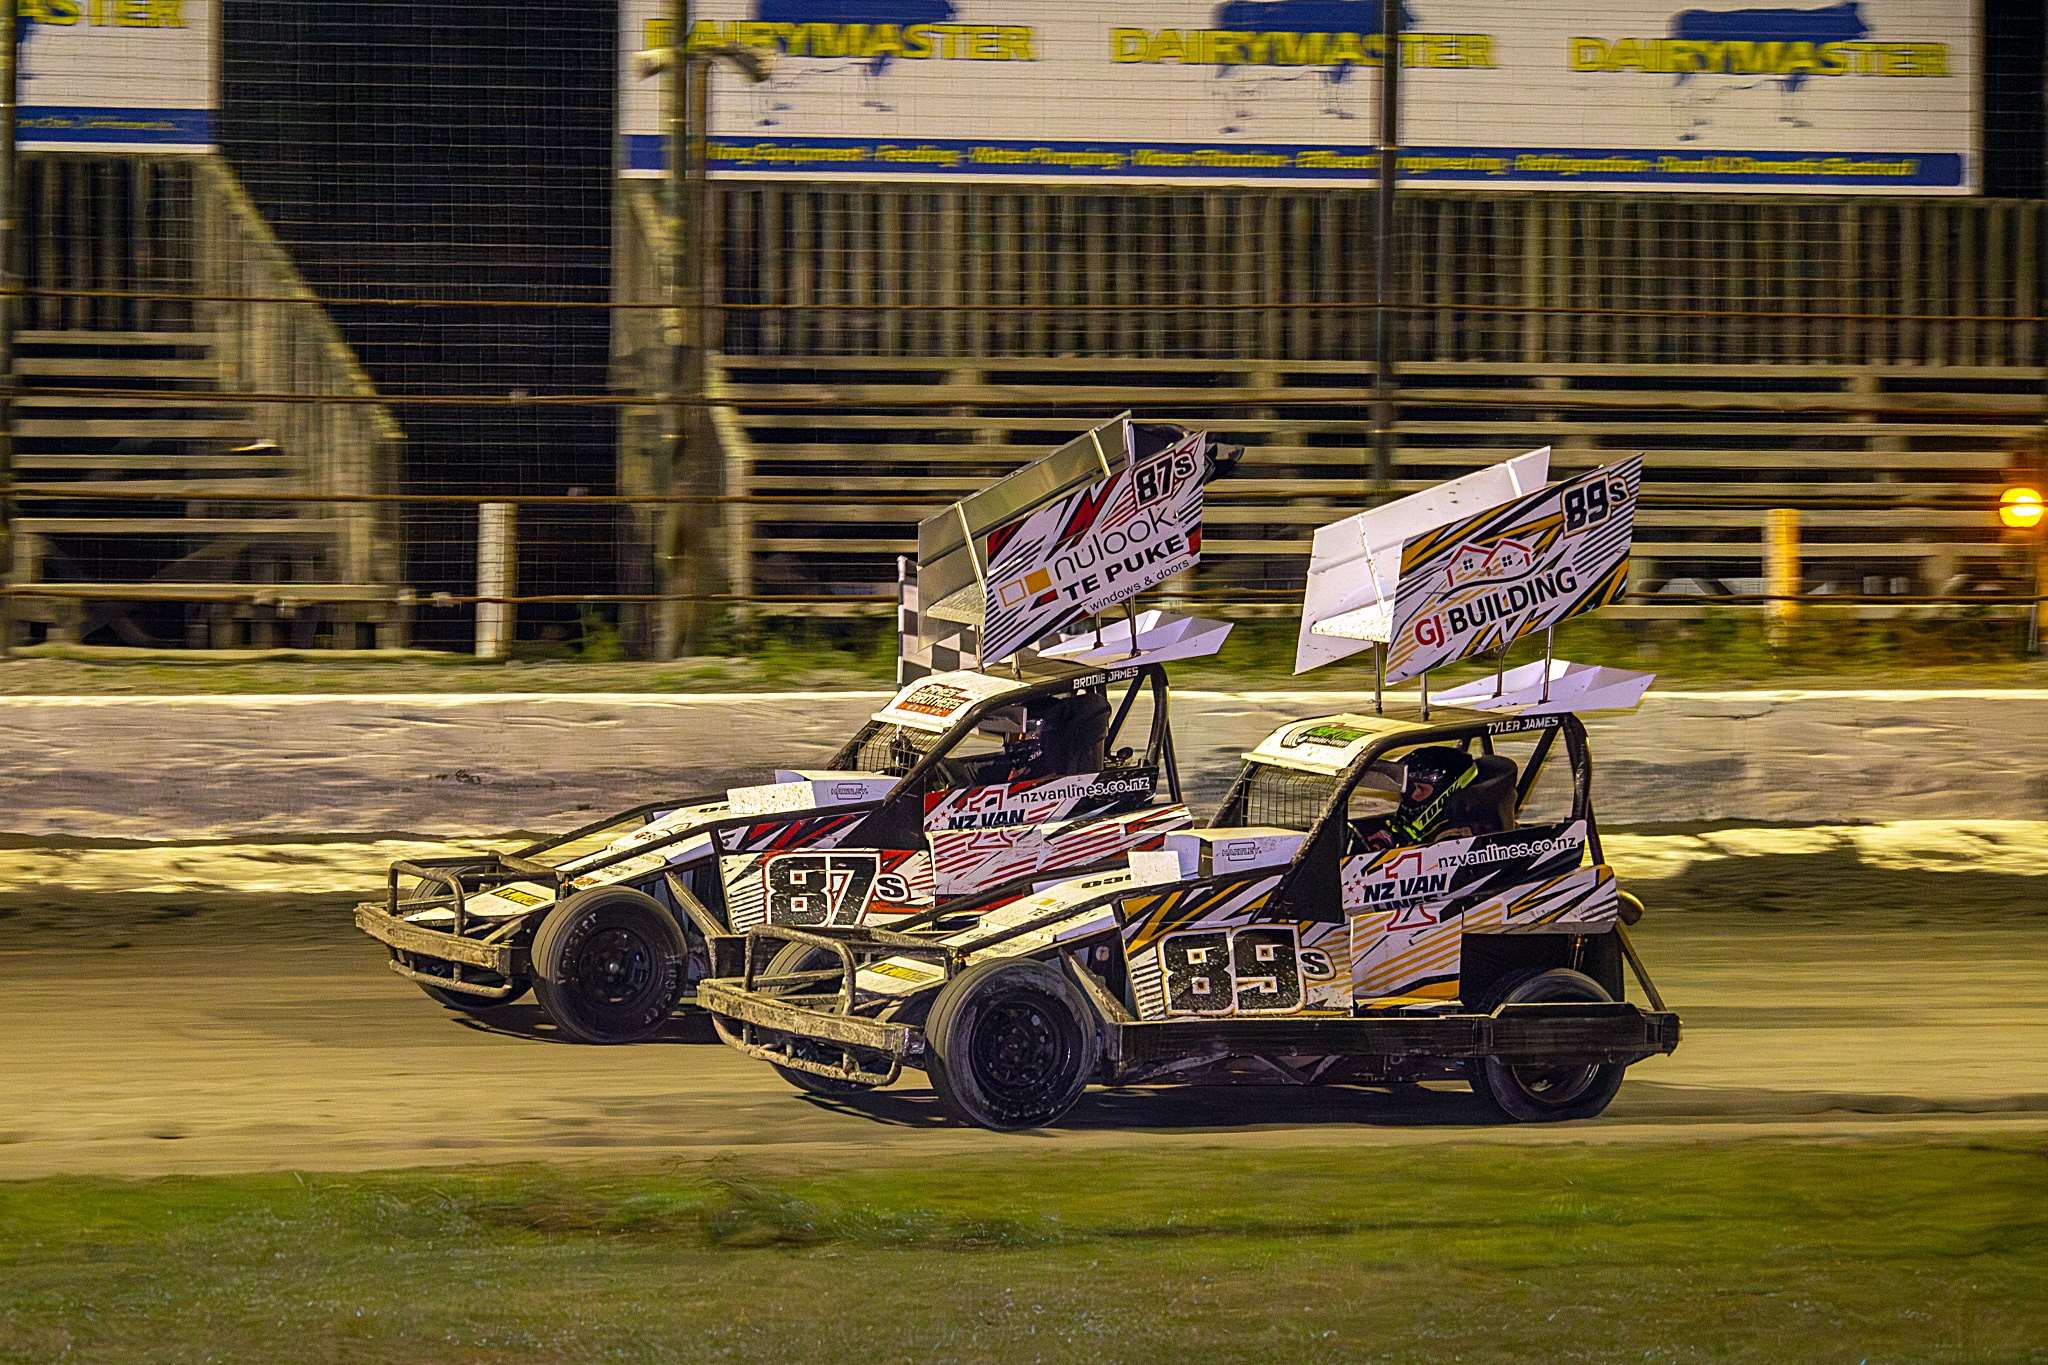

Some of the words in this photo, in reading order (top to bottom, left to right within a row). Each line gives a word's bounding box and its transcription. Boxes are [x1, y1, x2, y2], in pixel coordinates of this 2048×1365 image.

[1568, 36, 1952, 77] DAIRYMASTER
[1055, 508, 1176, 581] nulook
[1062, 573, 1101, 601] TE
[1105, 534, 1184, 583] PUKE
[1089, 583, 1141, 612] windows
[1144, 576, 1155, 586] &
[1156, 559, 1190, 581] doors
[1414, 618, 1445, 649] GJ
[1448, 566, 1578, 635] BUILDING
[1073, 673, 1106, 690] BRODIE
[1107, 666, 1139, 682] JAMES
[1486, 720, 1520, 734] TYLER
[1521, 716, 1559, 730] JAMES
[1020, 776, 1150, 803] nzvanlines.co.nz
[948, 816, 978, 831] NZ
[981, 808, 1025, 828] VAN
[1438, 836, 1577, 870] nzvanlines.co.nz
[1363, 881, 1396, 903] NZ
[1400, 872, 1448, 897] VAN
